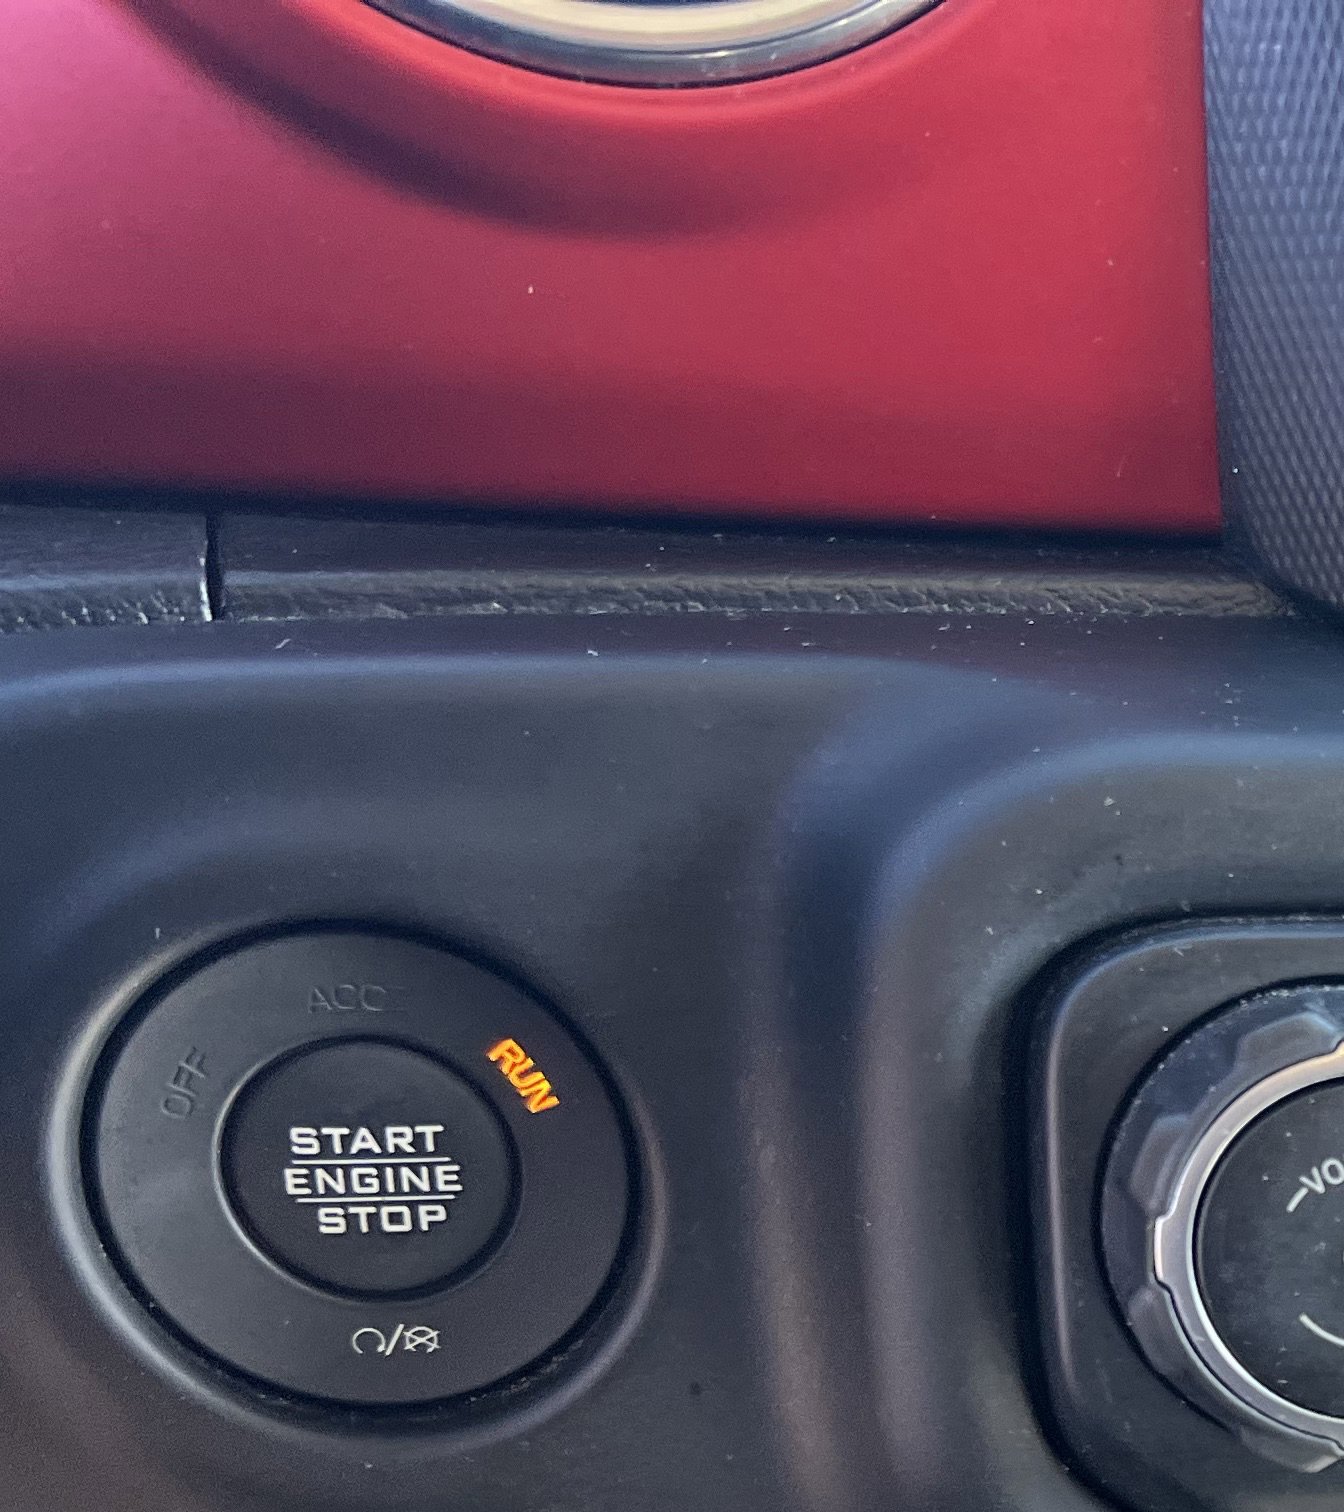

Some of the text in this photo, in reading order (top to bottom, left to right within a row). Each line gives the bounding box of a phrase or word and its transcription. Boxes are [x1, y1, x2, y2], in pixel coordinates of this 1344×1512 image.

[308, 984, 388, 1012] ACC
[161, 1047, 211, 1120] OFF
[486, 1038, 560, 1114] RUN
[289, 1124, 444, 1155] START
[283, 1164, 463, 1195] ENGINE
[317, 1204, 447, 1234] STOP
